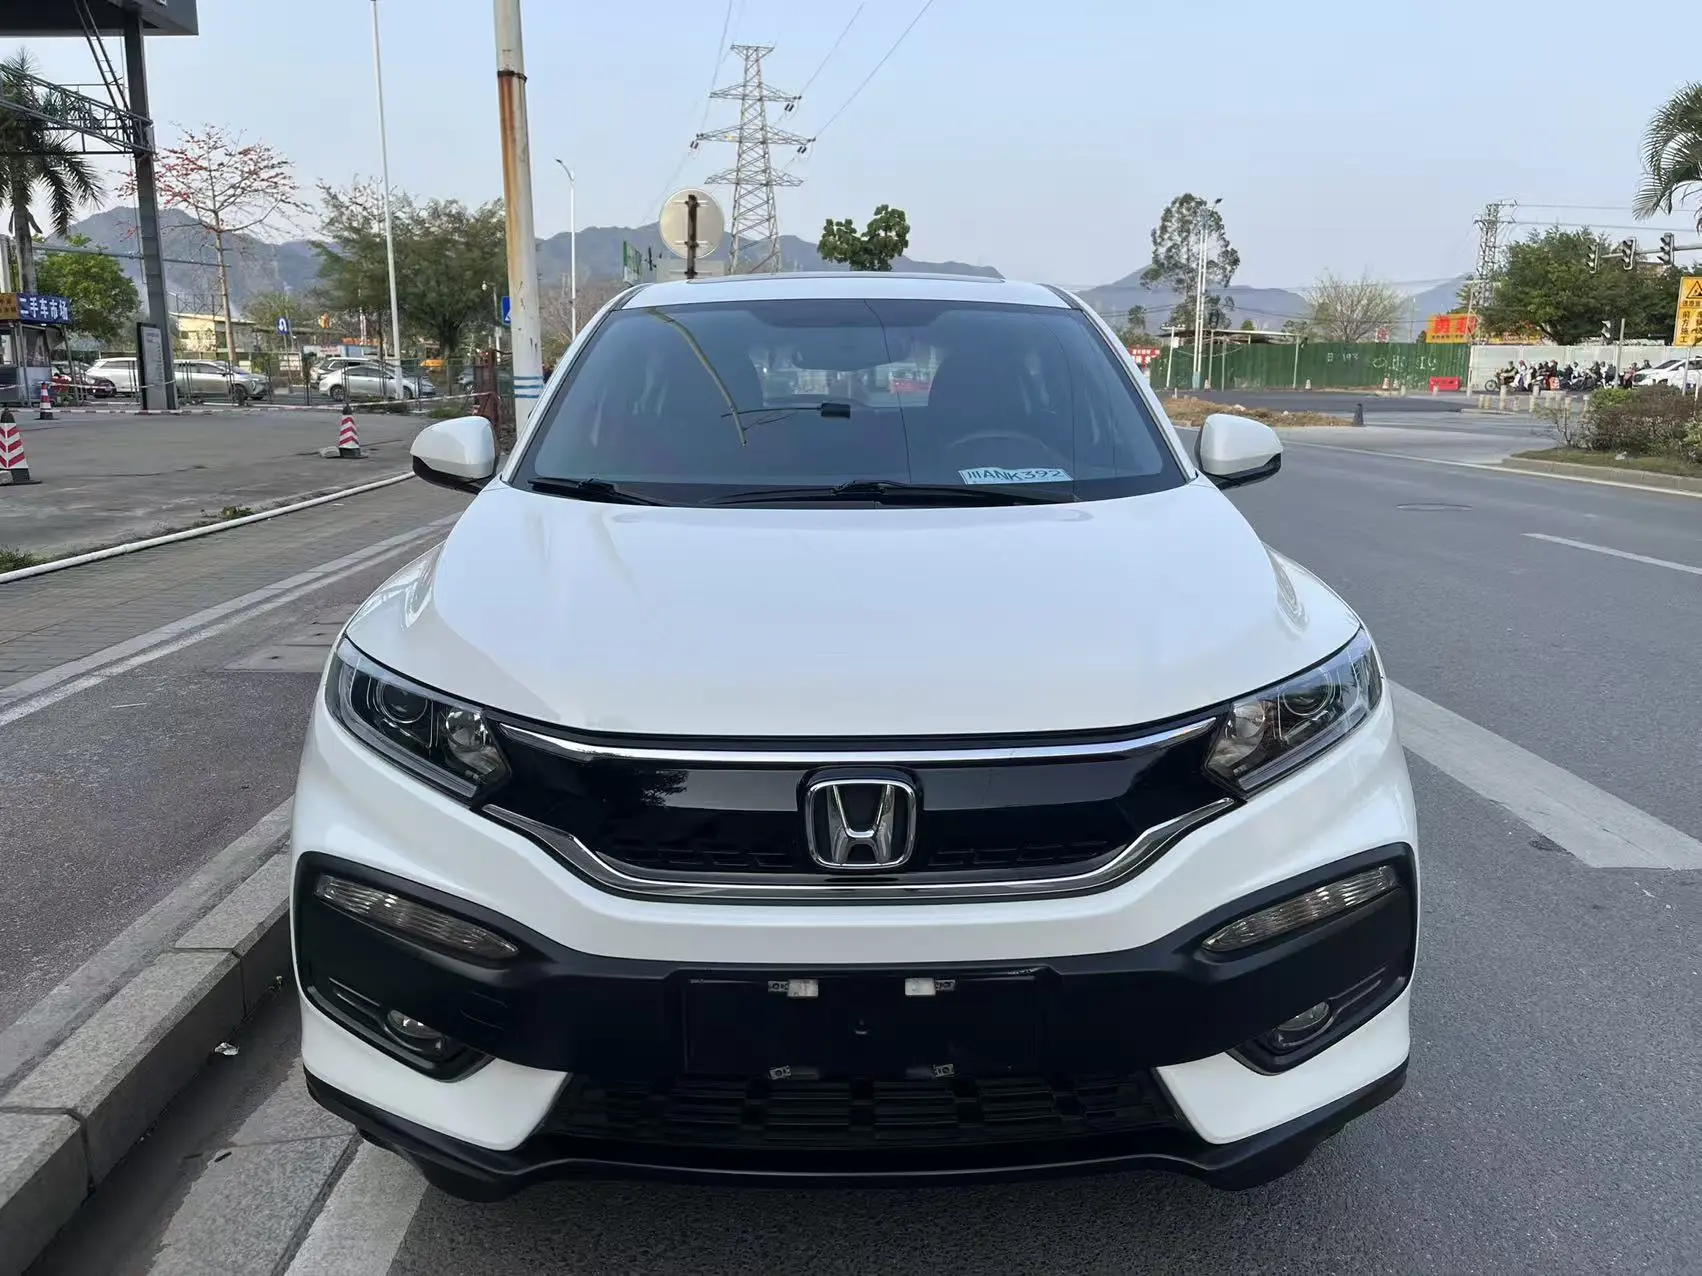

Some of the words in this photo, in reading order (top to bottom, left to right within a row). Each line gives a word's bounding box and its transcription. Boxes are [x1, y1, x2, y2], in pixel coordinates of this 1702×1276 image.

[20, 297, 68, 320] 二手车市场
[1680, 311, 1690, 343] 前方施工
